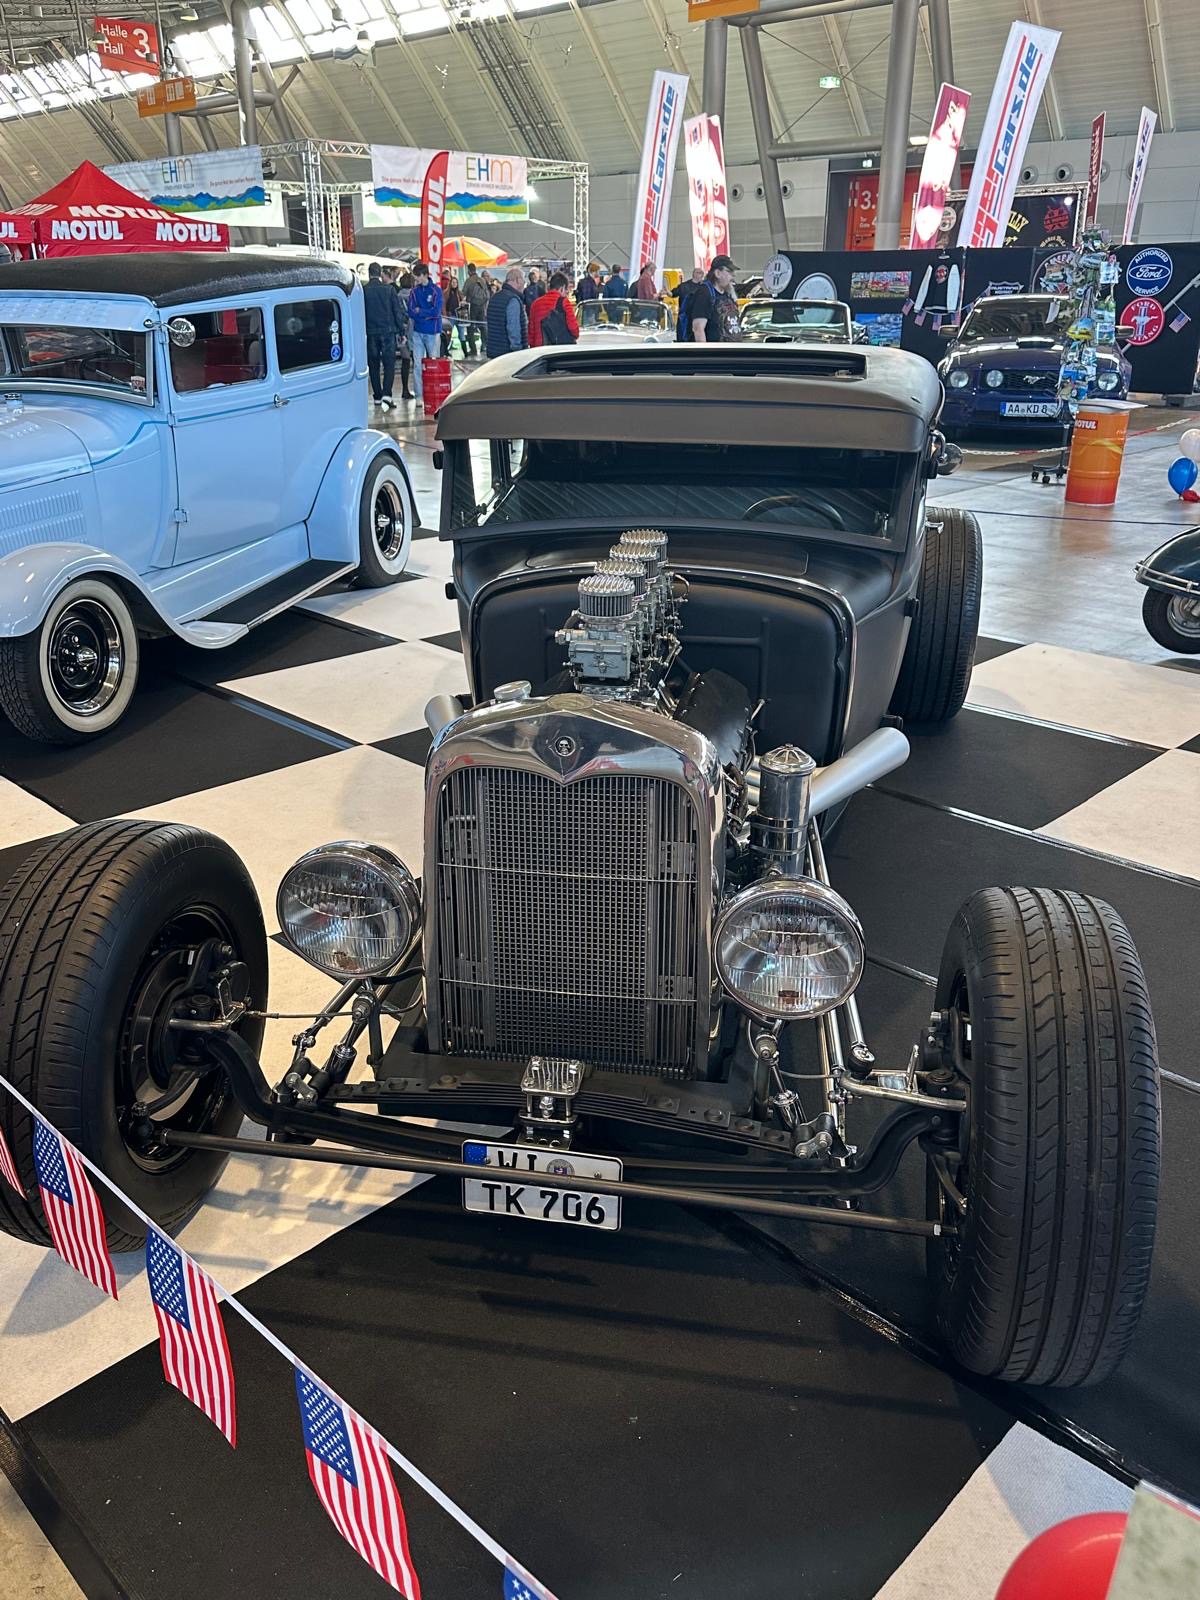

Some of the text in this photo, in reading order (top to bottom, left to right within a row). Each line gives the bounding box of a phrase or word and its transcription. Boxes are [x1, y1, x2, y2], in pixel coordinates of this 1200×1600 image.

[100, 23, 151, 58] Halle 3
[103, 42, 124, 55] Hall
[970, 42, 1039, 248] igerCars.de
[639, 85, 675, 268] eigerCars.de
[860, 190, 880, 210] 3.
[68, 204, 180, 221] MOTUL
[51, 220, 124, 240] MOTUL
[155, 222, 222, 243] MOTUL
[1134, 249, 1169, 264] AUTHORIZED
[1135, 266, 1163, 278] Ford
[1134, 285, 1160, 295] SERVICE
[1130, 301, 1157, 311] FORD
[1131, 324, 1159, 342] STANG
[1007, 406, 1020, 414] AA
[1026, 405, 1039, 413] KD
[497, 1150, 538, 1171] WI
[481, 1182, 606, 1225] TK 706
